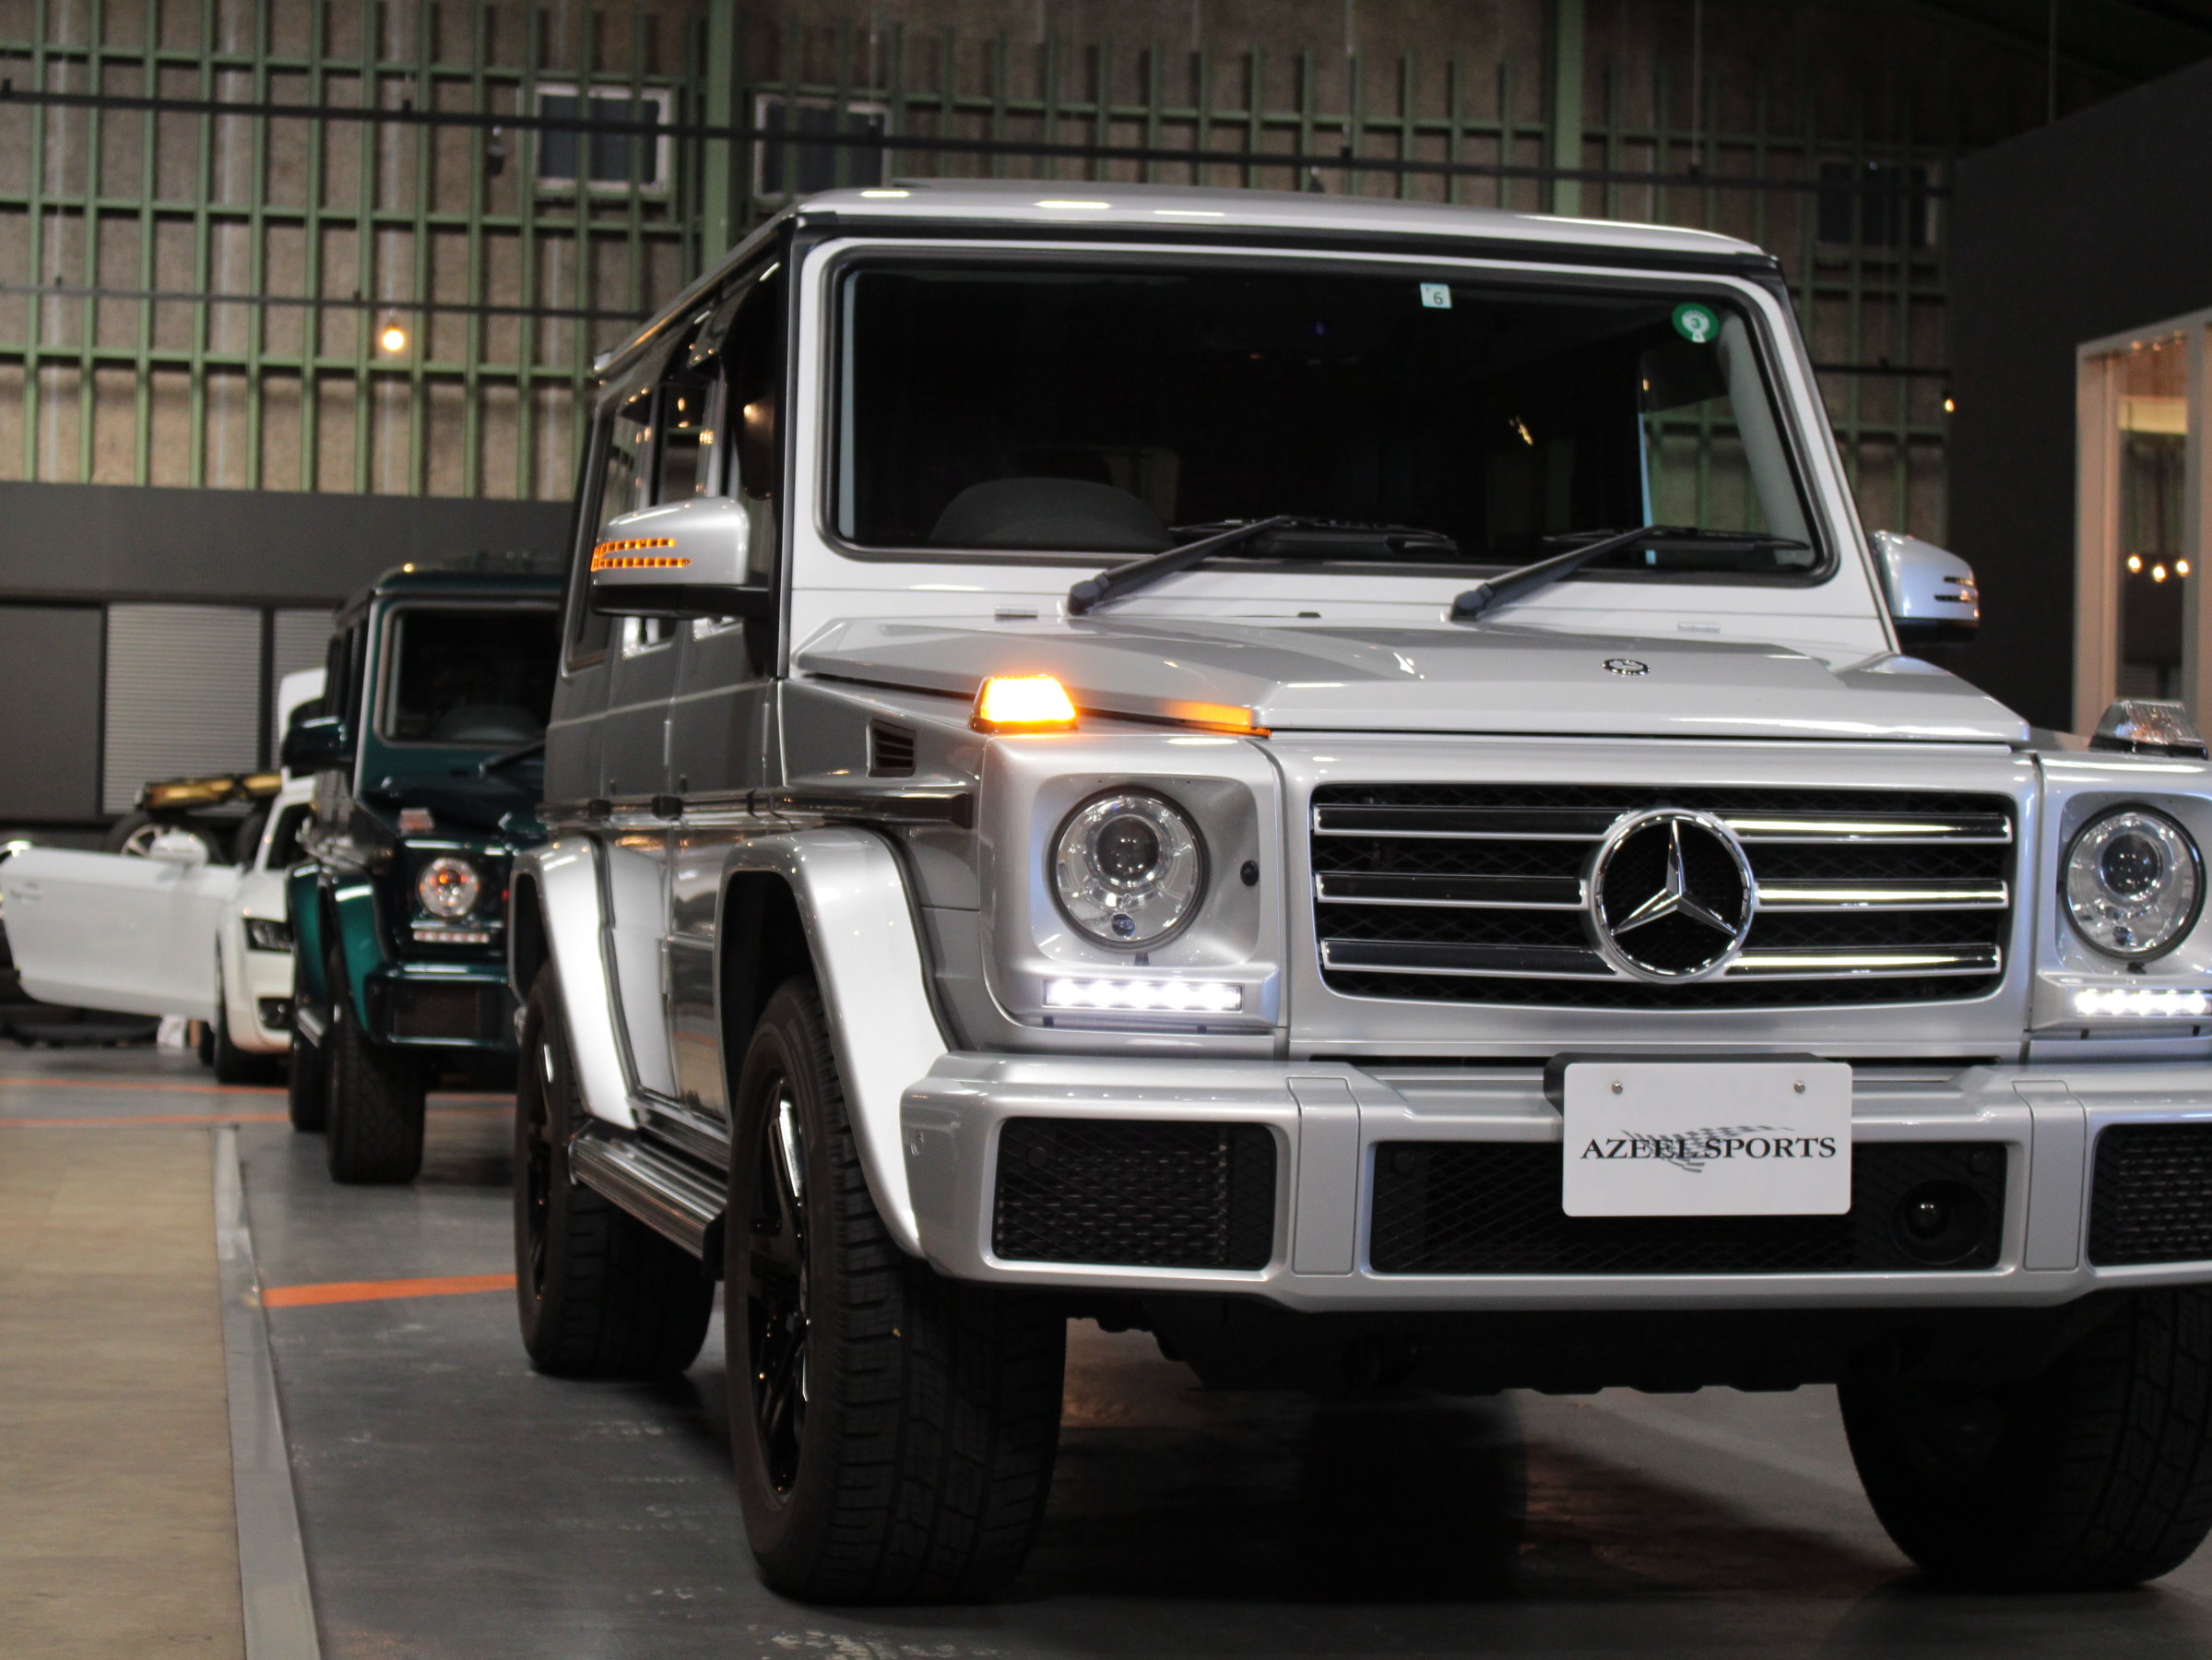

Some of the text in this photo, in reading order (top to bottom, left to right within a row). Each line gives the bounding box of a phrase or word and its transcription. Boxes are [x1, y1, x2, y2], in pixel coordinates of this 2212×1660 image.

[1433, 291, 1443, 305] 6
[1579, 1137, 1837, 1159] AZEEL SPORTS
